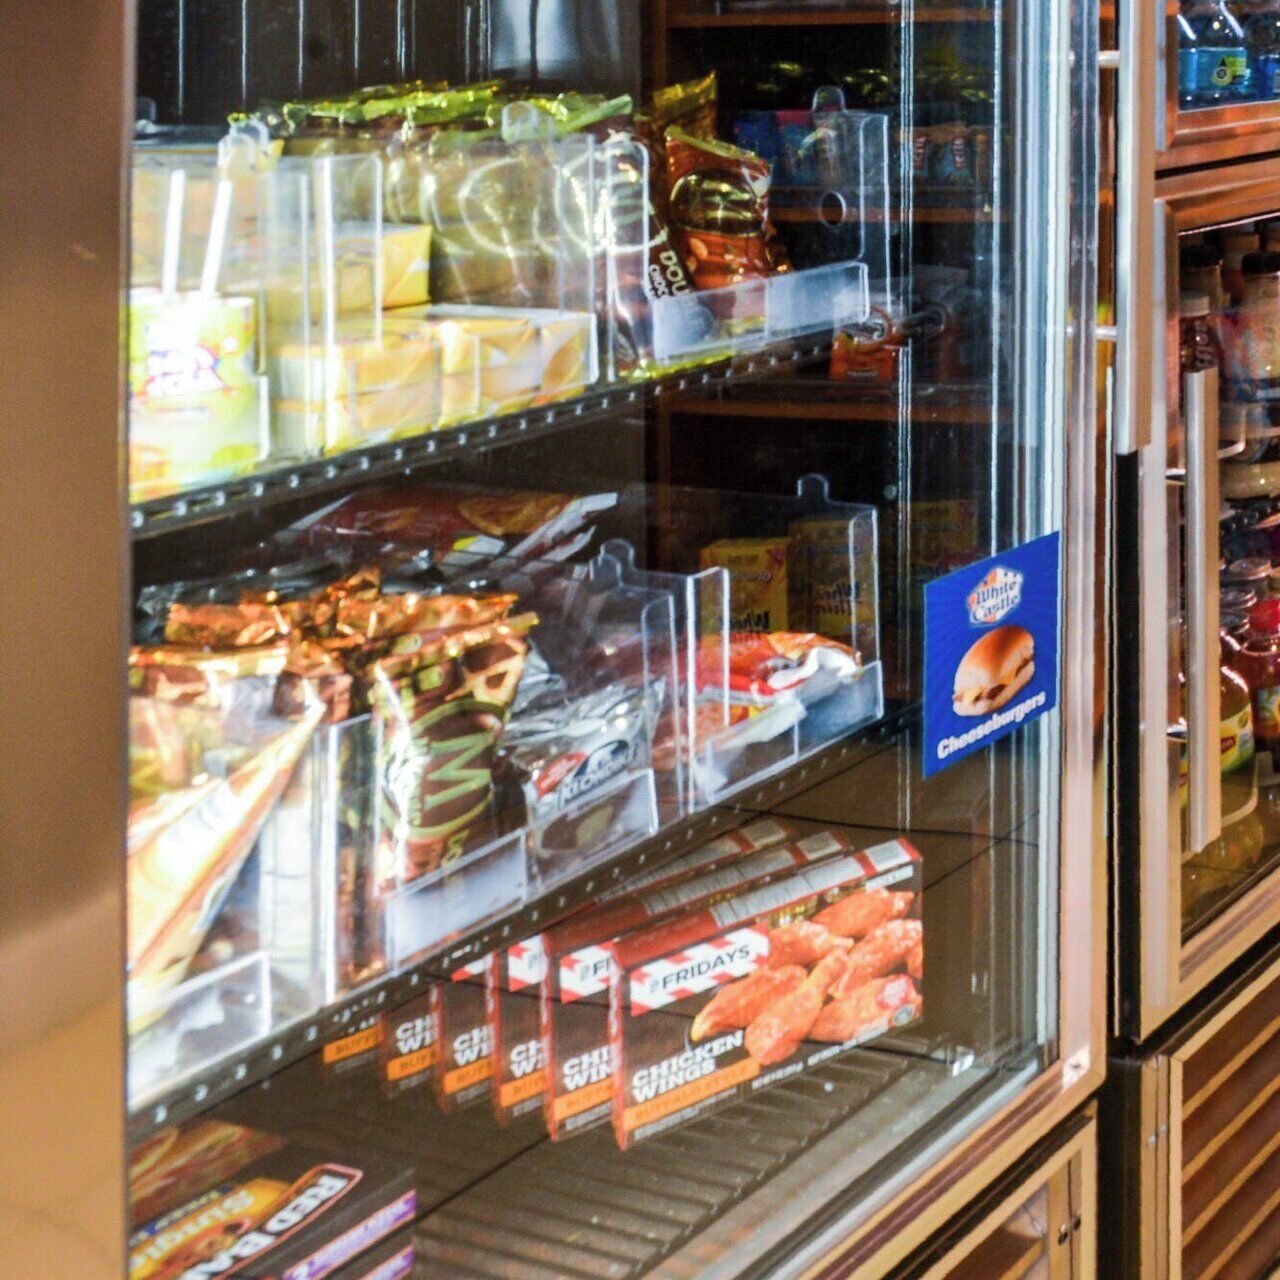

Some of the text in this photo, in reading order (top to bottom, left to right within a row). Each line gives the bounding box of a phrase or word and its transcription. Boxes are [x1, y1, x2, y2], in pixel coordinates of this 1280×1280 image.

[971, 593, 1019, 623] Castle
[974, 580, 1018, 606] White
[936, 690, 1047, 760] Cheeseburgers
[662, 943, 751, 991] FRIDAYS
[631, 1028, 745, 1086] CHICKEN
[631, 1056, 717, 1104] WINGS
[264, 1174, 351, 1234] RED
